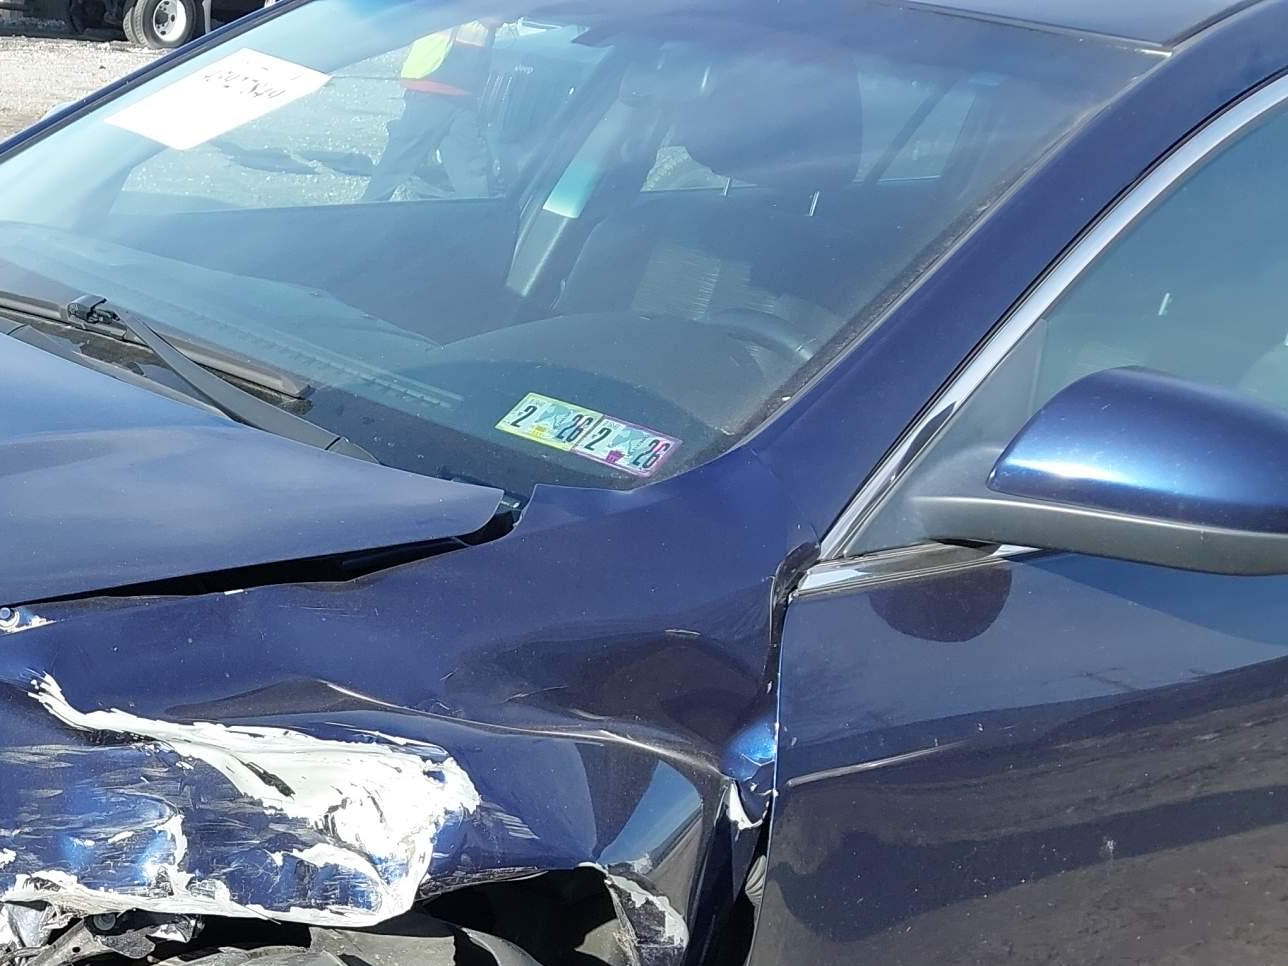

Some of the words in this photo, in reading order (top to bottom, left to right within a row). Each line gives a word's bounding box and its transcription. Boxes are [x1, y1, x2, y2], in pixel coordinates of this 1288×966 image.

[510, 405, 537, 428] 2
[555, 413, 594, 442] 26
[584, 427, 611, 451] 2
[632, 439, 671, 469] 26
